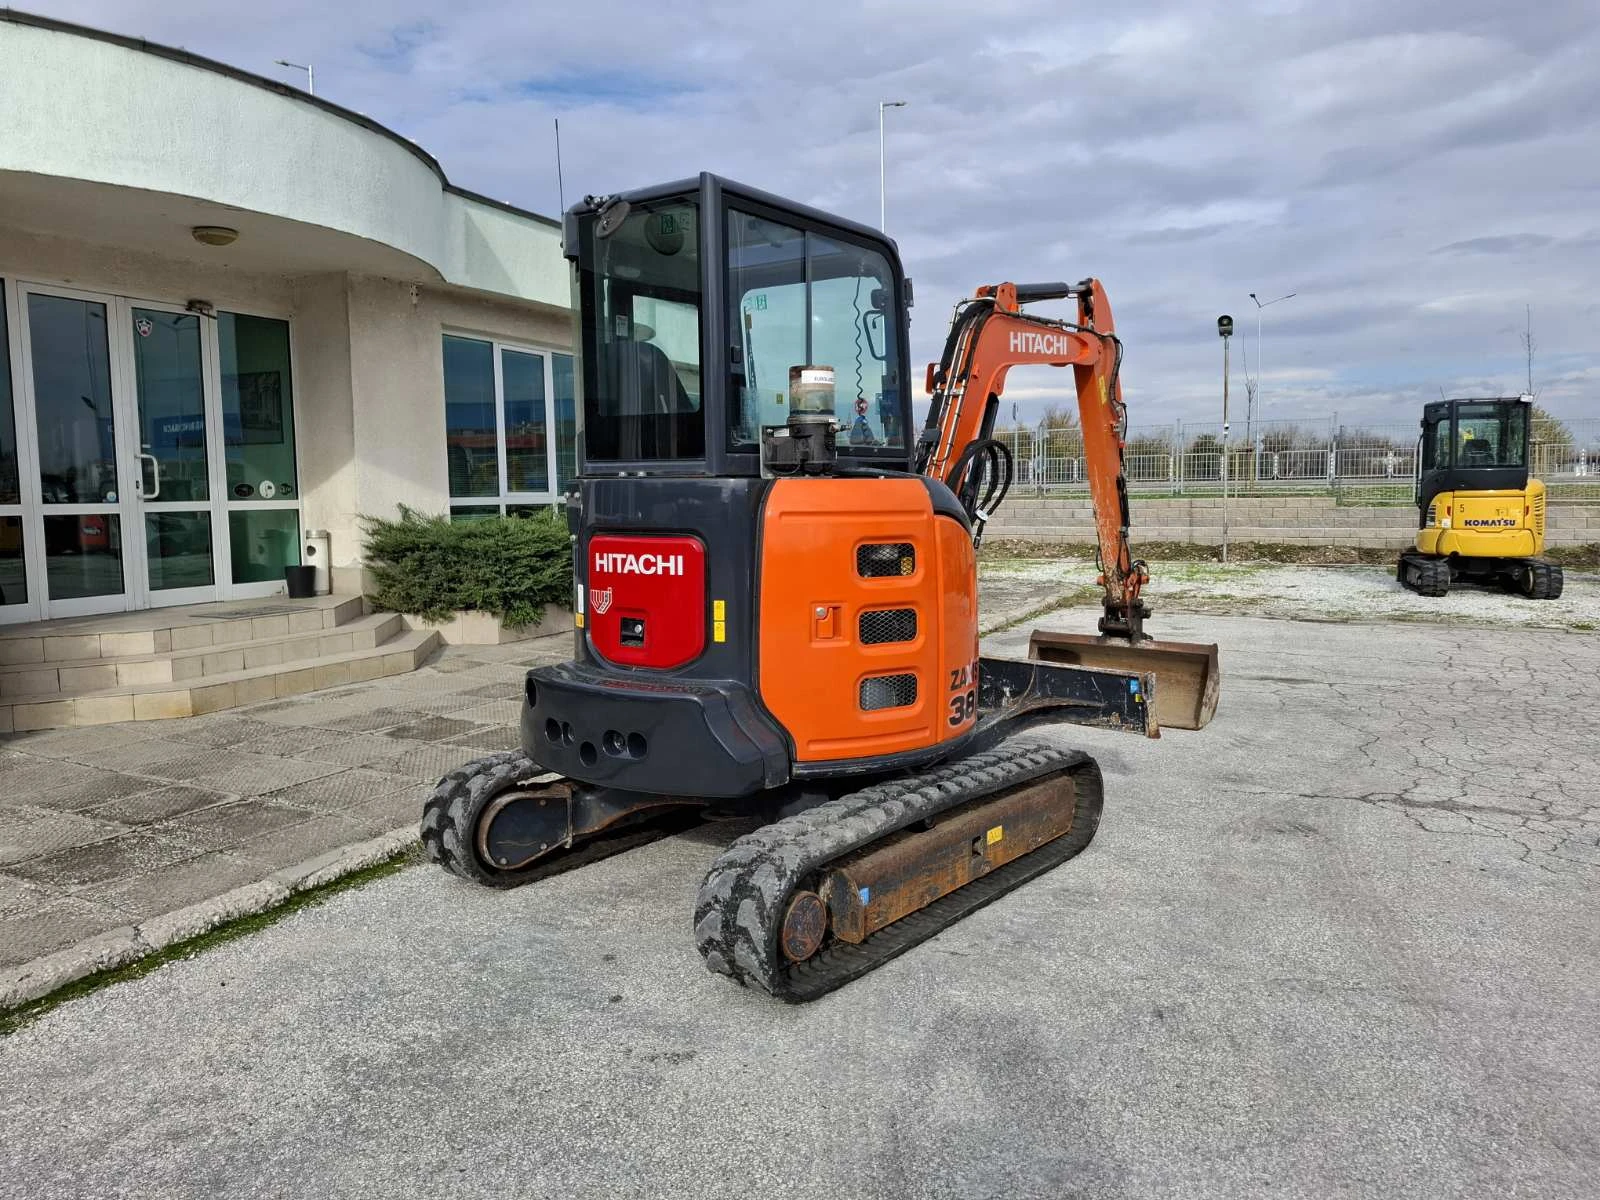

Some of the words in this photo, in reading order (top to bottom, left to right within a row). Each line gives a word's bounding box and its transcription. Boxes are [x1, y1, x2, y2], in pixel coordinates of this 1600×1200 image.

[1009, 331, 1068, 356] HITACHI
[1460, 504, 1465, 512] 5
[595, 552, 684, 576] HITACHI
[948, 689, 975, 727] 38
